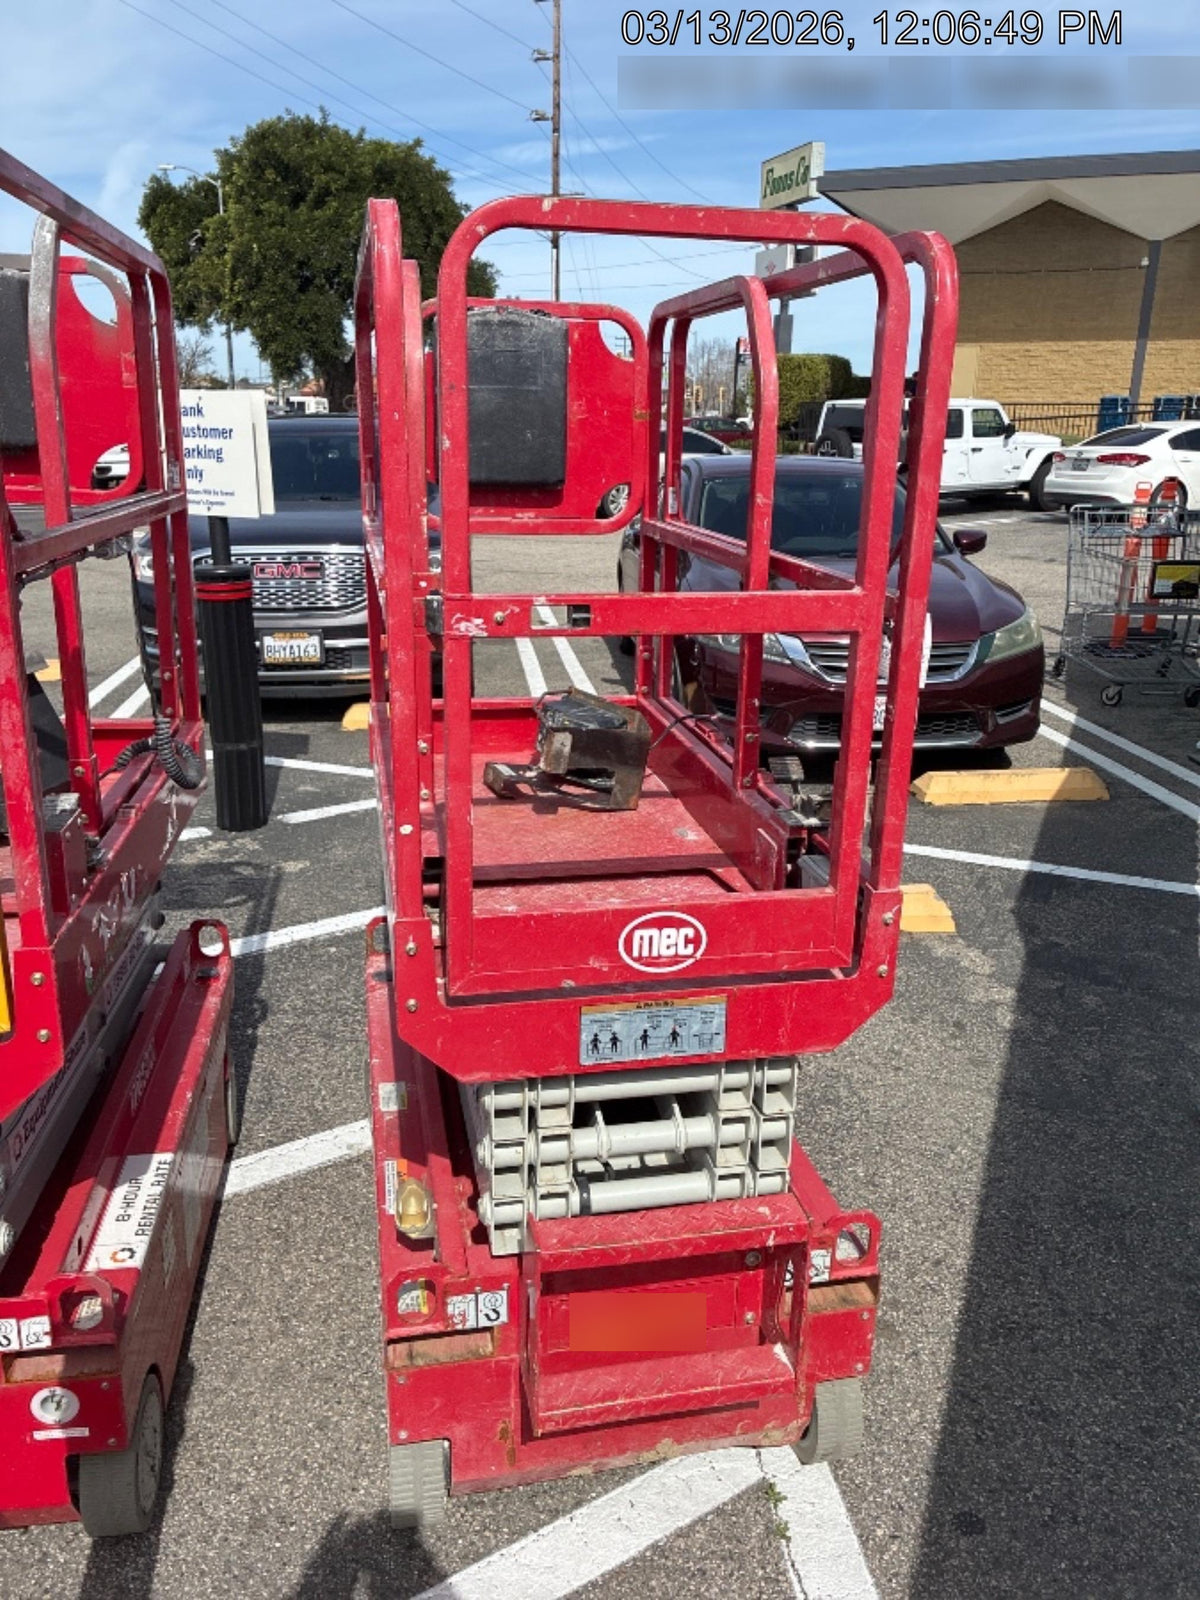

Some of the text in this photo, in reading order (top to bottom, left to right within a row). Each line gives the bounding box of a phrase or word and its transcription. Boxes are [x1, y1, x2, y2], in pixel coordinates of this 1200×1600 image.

[181, 403, 204, 417] ank
[182, 424, 234, 440] ustomer
[184, 445, 224, 463] arking
[186, 466, 204, 483] nly
[253, 562, 323, 579] GMC
[134, 1158, 172, 1237] RENTAL RATE
